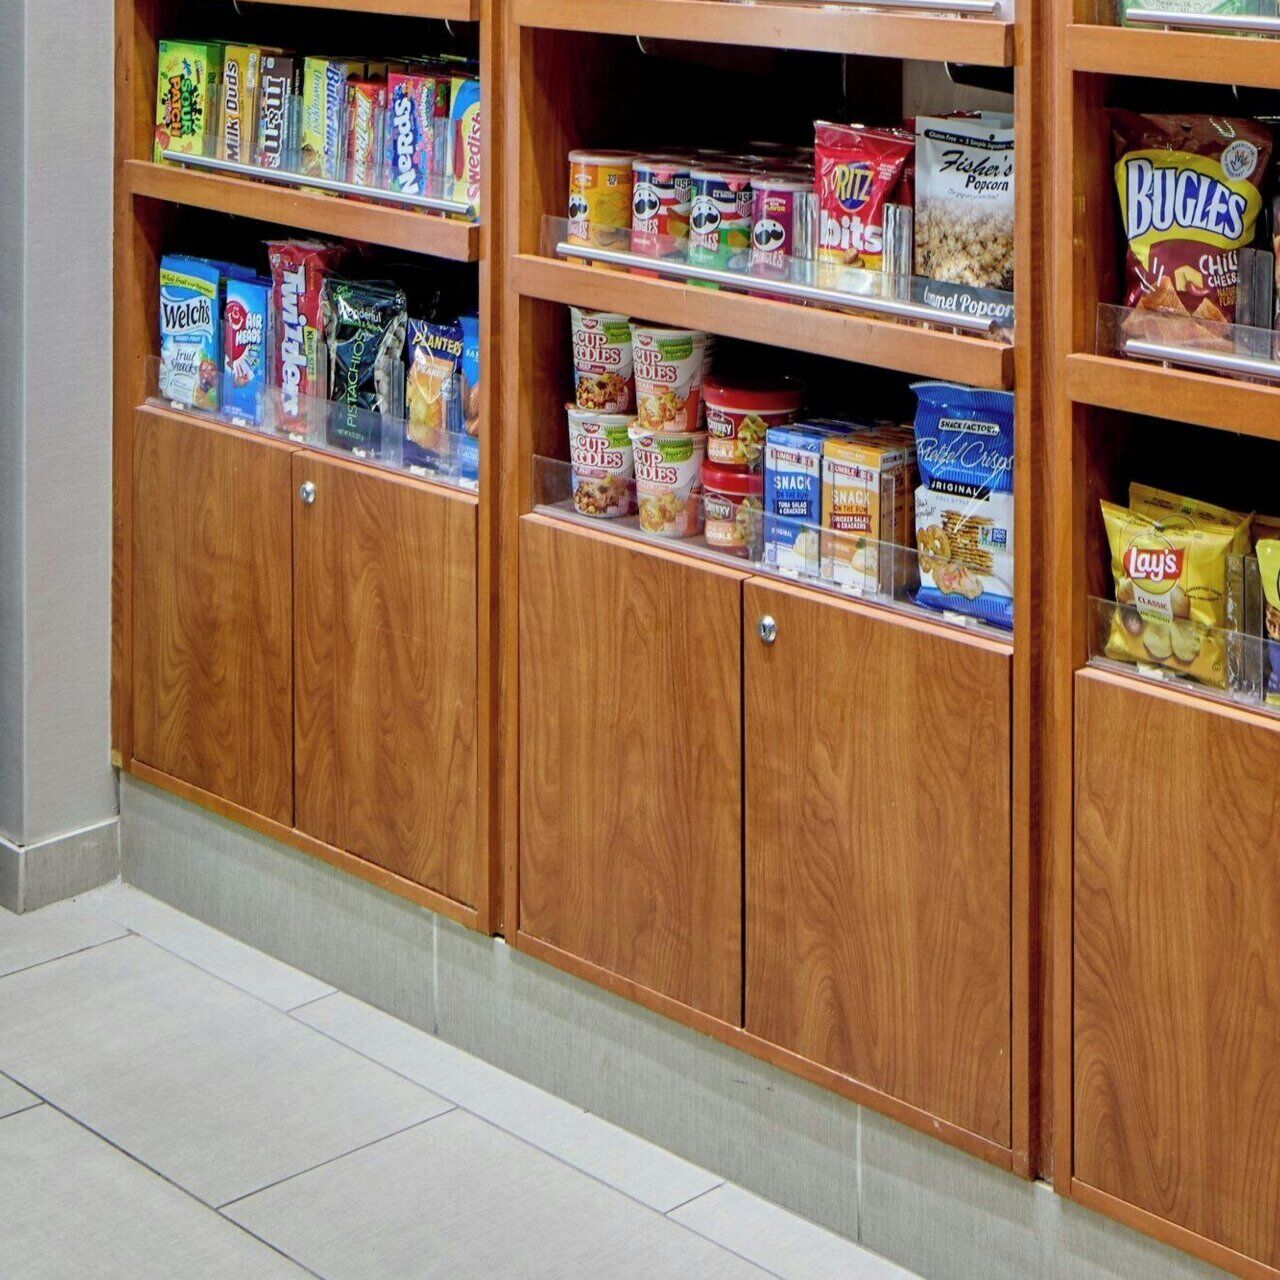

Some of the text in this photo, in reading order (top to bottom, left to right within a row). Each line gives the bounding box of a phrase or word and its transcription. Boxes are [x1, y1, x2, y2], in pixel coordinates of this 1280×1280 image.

[169, 75, 182, 139] PATCH
[180, 77, 194, 136] SOUR
[224, 60, 240, 162] Milk Duds
[466, 110, 480, 198] Swedish
[940, 149, 1014, 180] Fisher's
[833, 166, 875, 206] RITZ
[965, 177, 1008, 197] Popcorn
[1126, 158, 1248, 241] BUGLES
[820, 210, 883, 252] bits
[163, 299, 211, 329] Welch's
[245, 313, 264, 331] AIR
[235, 328, 262, 346] HEADS
[411, 329, 464, 355] PLANTERS
[577, 332, 607, 352] CUP
[176, 348, 197, 362] Fruit
[634, 350, 663, 368] CUP
[171, 357, 199, 374] Snacks
[346, 329, 366, 428] PISTACHIOS
[941, 421, 961, 432] SNACK
[577, 435, 610, 454] CUP
[633, 450, 663, 468] CUP
[964, 439, 1014, 475] Crisps
[773, 475, 812, 490] SNACK
[831, 488, 870, 505] SNACK
[778, 502, 808, 514] TUNA SALAD
[783, 510, 807, 518] CRACKERS
[833, 505, 853, 514] ON THE
[1130, 548, 1180, 585] Lay's
[1137, 596, 1170, 611] CLASSIC
